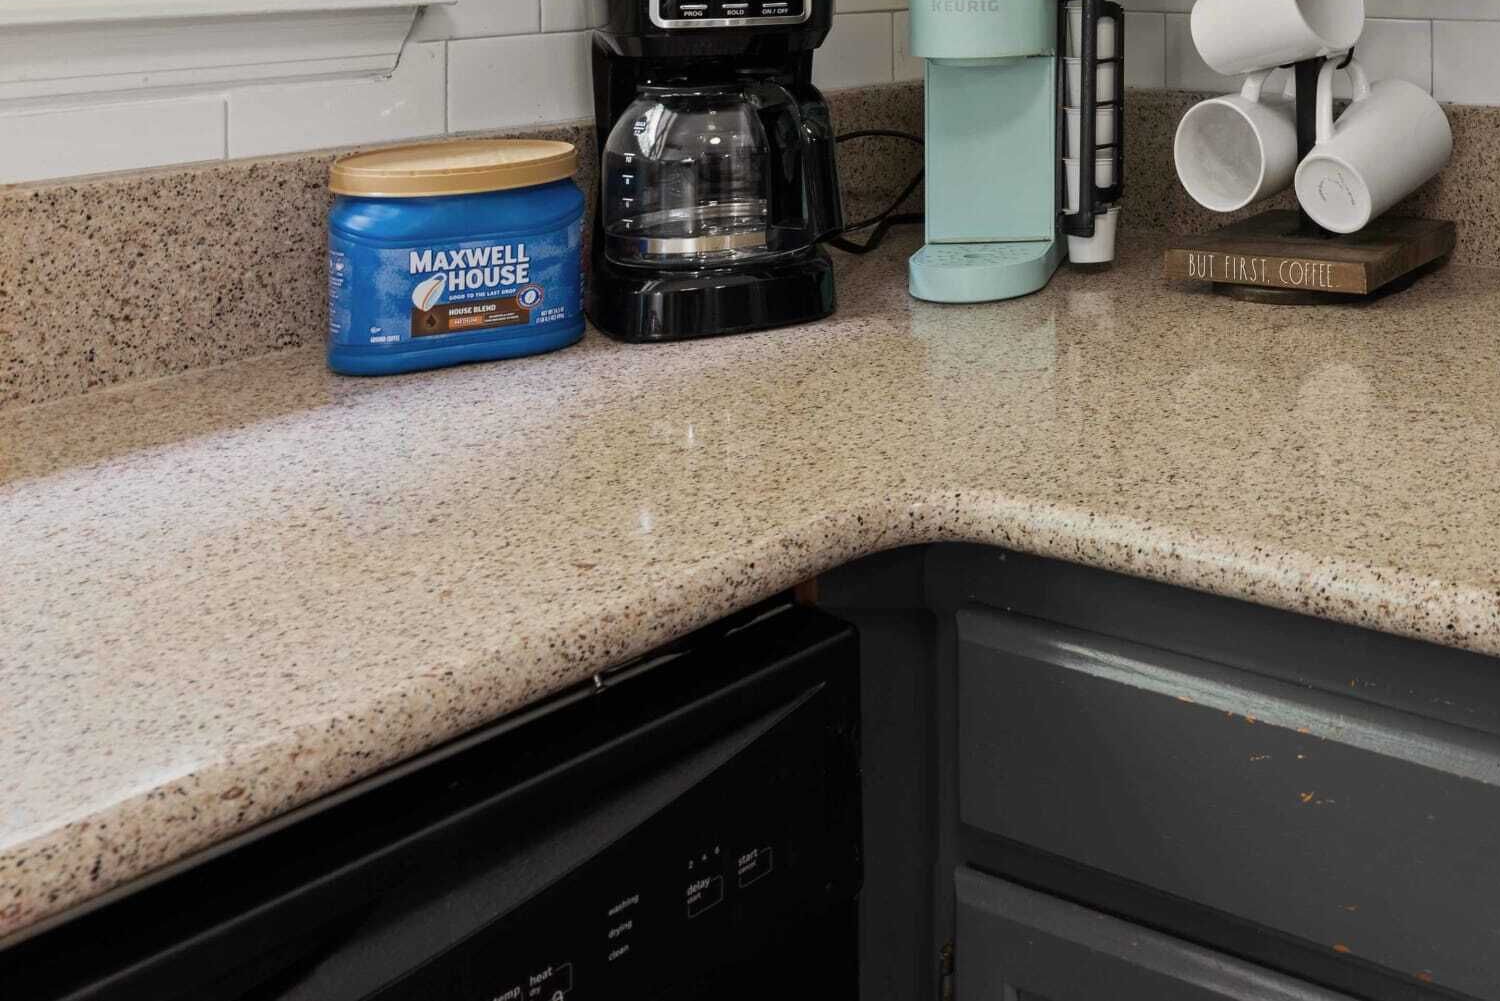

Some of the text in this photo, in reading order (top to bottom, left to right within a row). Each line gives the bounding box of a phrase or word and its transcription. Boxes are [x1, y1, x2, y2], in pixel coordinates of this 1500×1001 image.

[931, 0, 1000, 13] KEURIG
[409, 243, 530, 274] MAXWELL
[1189, 253, 1215, 278] BUT
[448, 263, 530, 292] HOUSE
[448, 303, 497, 317] HOUSE BLEND
[738, 848, 758, 868] start
[686, 876, 711, 897] delay
[529, 965, 553, 988] heat
